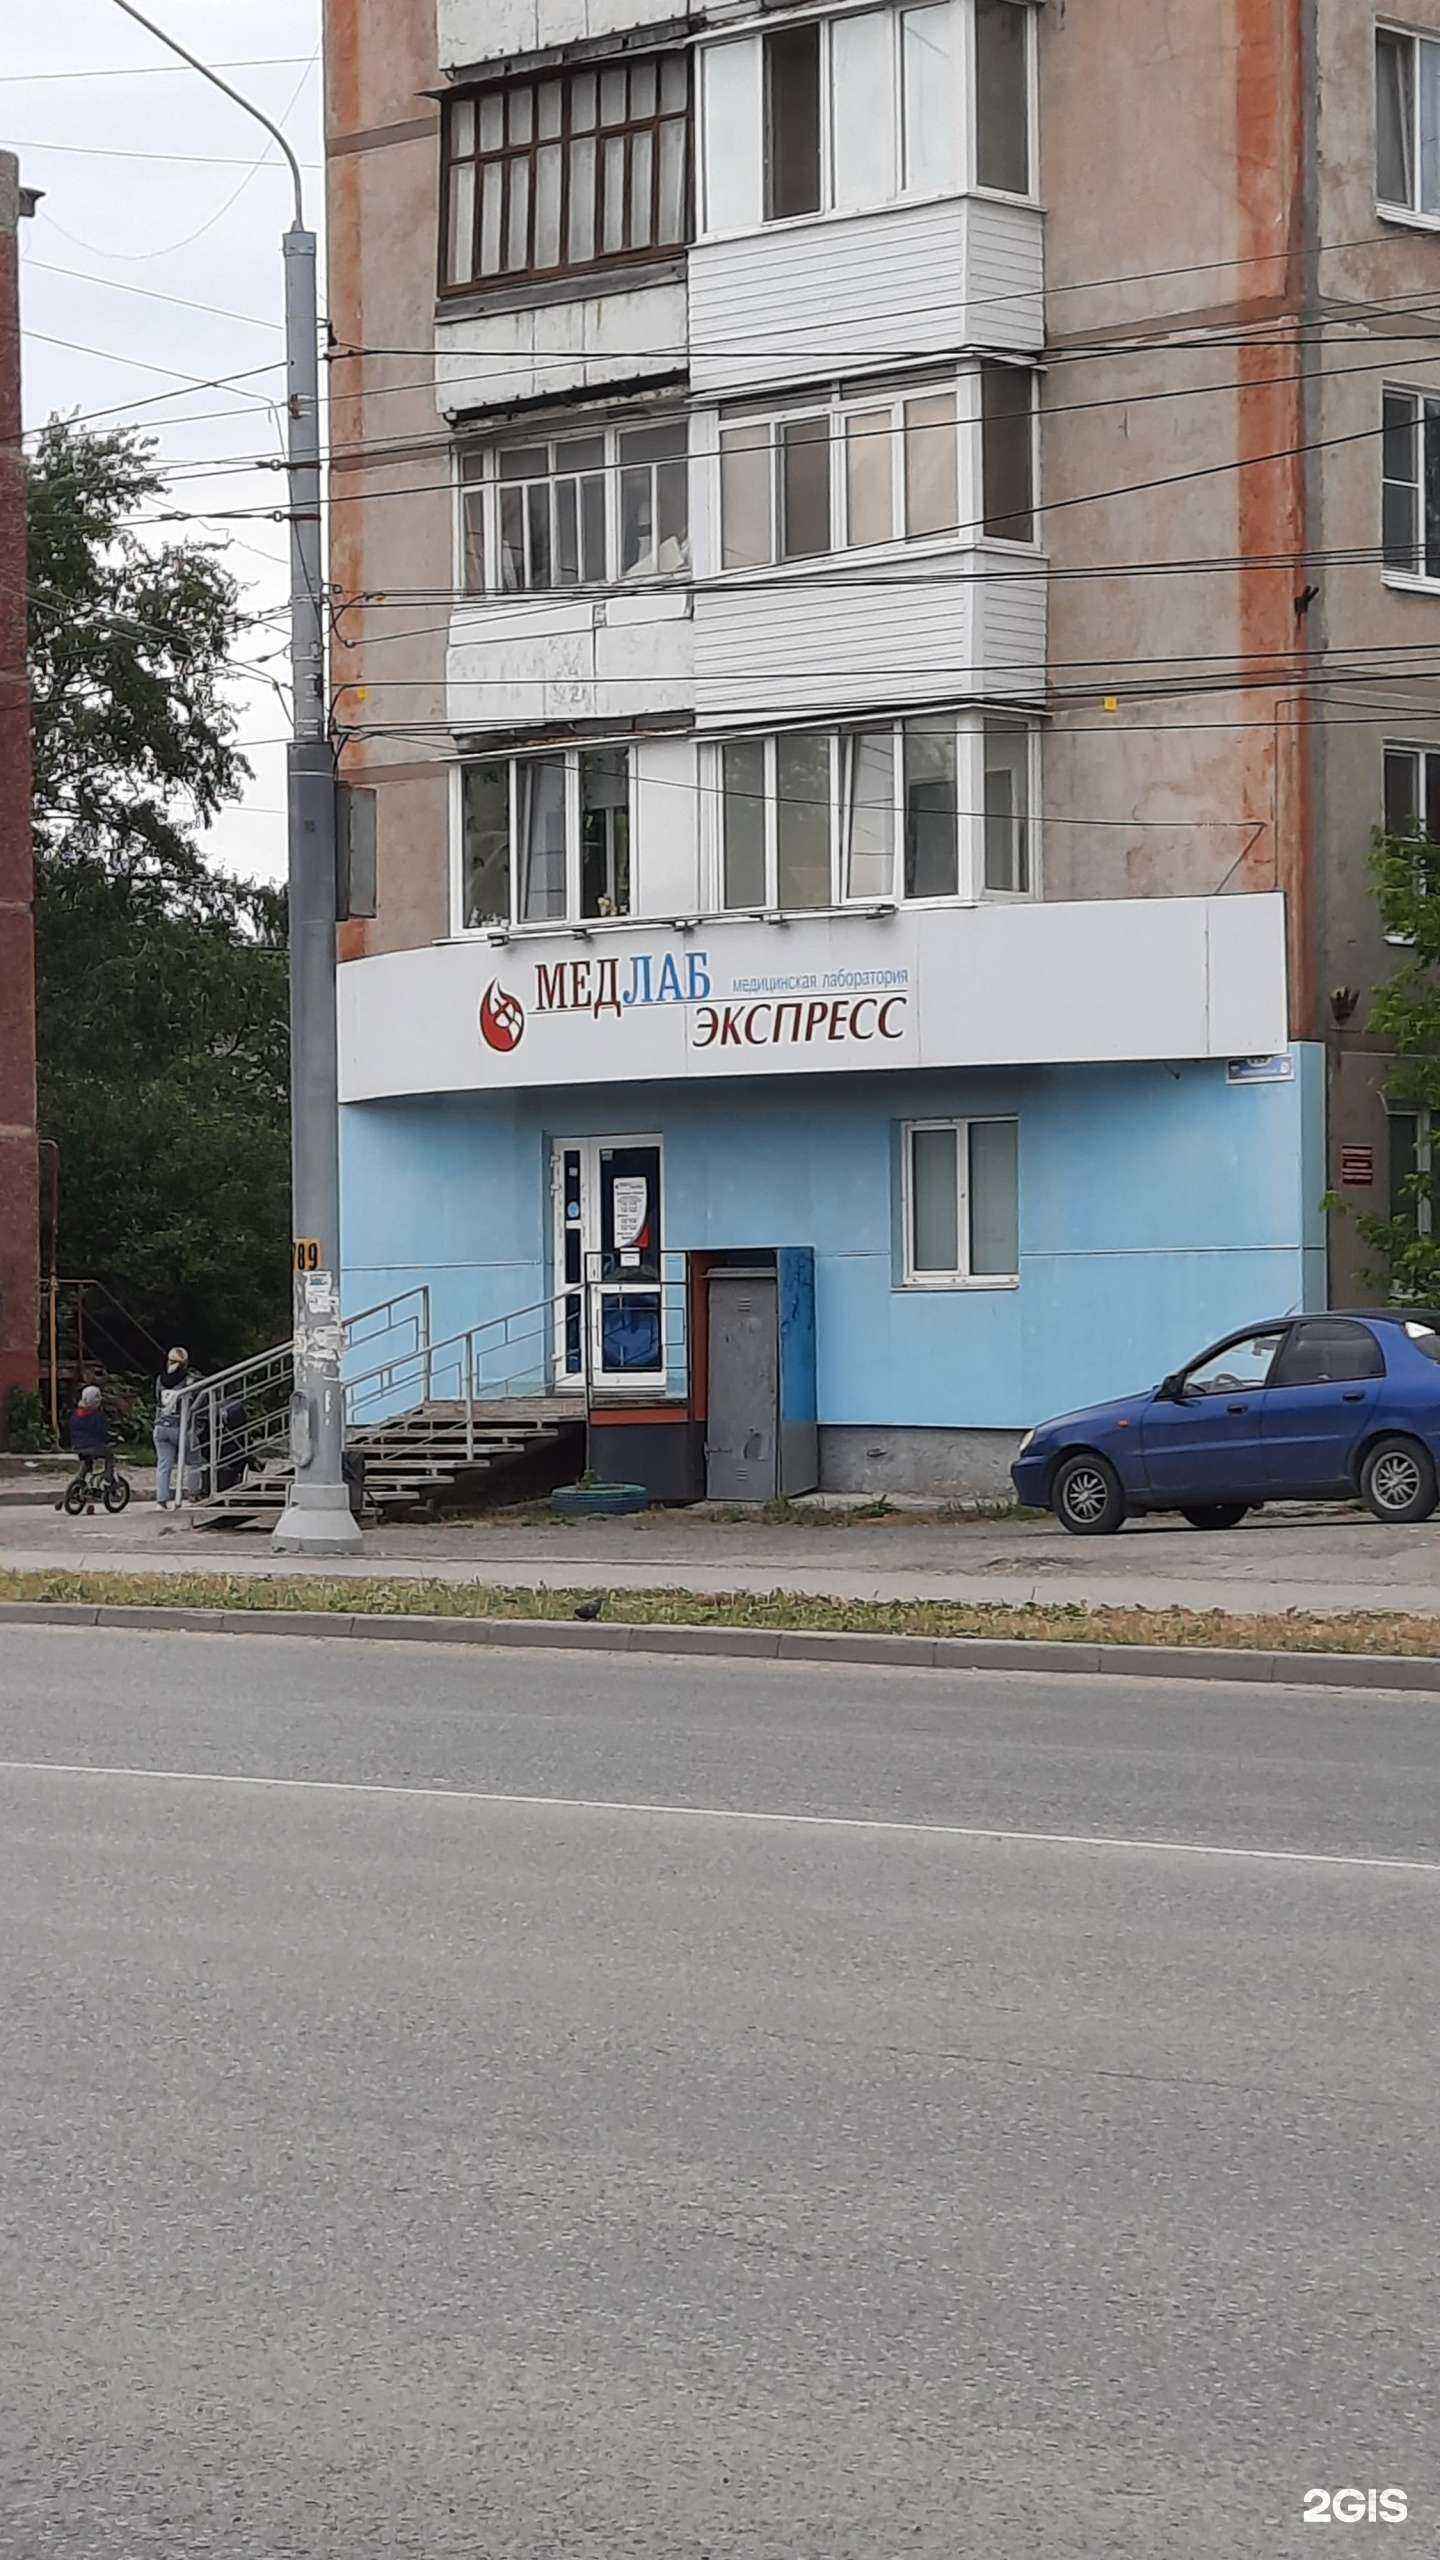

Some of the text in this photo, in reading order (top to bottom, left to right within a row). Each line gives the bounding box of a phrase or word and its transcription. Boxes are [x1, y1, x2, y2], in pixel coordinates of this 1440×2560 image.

[534, 951, 711, 1020] МЕДЛАБ
[732, 967, 909, 993] медицинская лаборатория
[691, 996, 908, 1048] ЭКСПРЕСС
[293, 1241, 319, 1271] 89
